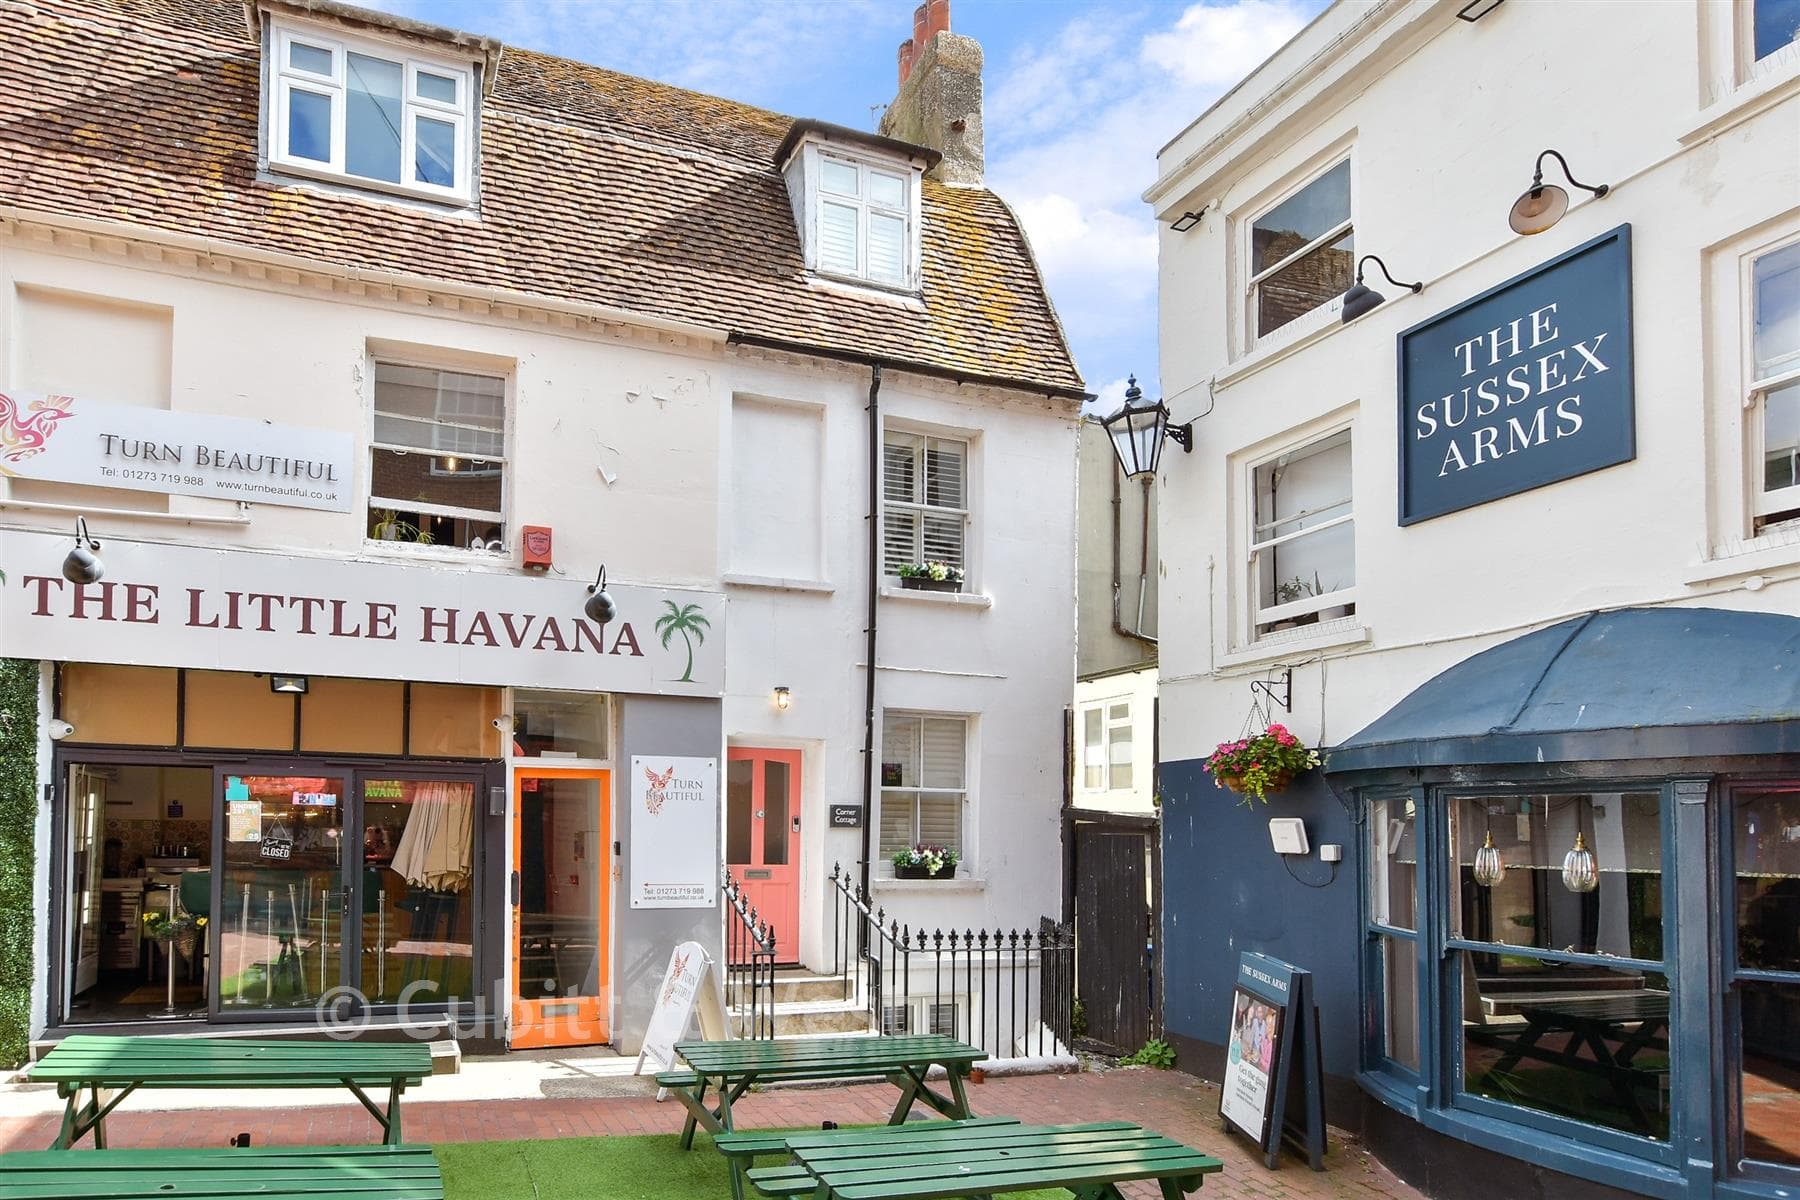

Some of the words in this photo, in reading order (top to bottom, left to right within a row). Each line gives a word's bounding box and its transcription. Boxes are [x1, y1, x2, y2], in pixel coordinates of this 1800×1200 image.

[1455, 302, 1559, 377] THE
[1416, 332, 1610, 440] SUSSEX
[99, 432, 183, 463] TURN
[195, 444, 338, 482] BEAUTIFUL
[1438, 394, 1584, 478] ARMS
[99, 466, 119, 478] Tel:
[122, 468, 157, 482] 01273
[160, 473, 181, 485] 719
[184, 475, 205, 487] 988
[215, 480, 338, 502] www.turnbeautiful.co.uk
[23, 575, 159, 625] THE
[185, 588, 397, 641] LITTLE
[419, 605, 645, 657] HAVANA
[671, 778, 704, 790] TURN
[835, 816, 856, 824] Cottage
[261, 845, 290, 858] CLOSED
[1241, 964, 1253, 977] THE
[1252, 968, 1272, 985] SUSSEX
[1270, 977, 1288, 992] ARMS
